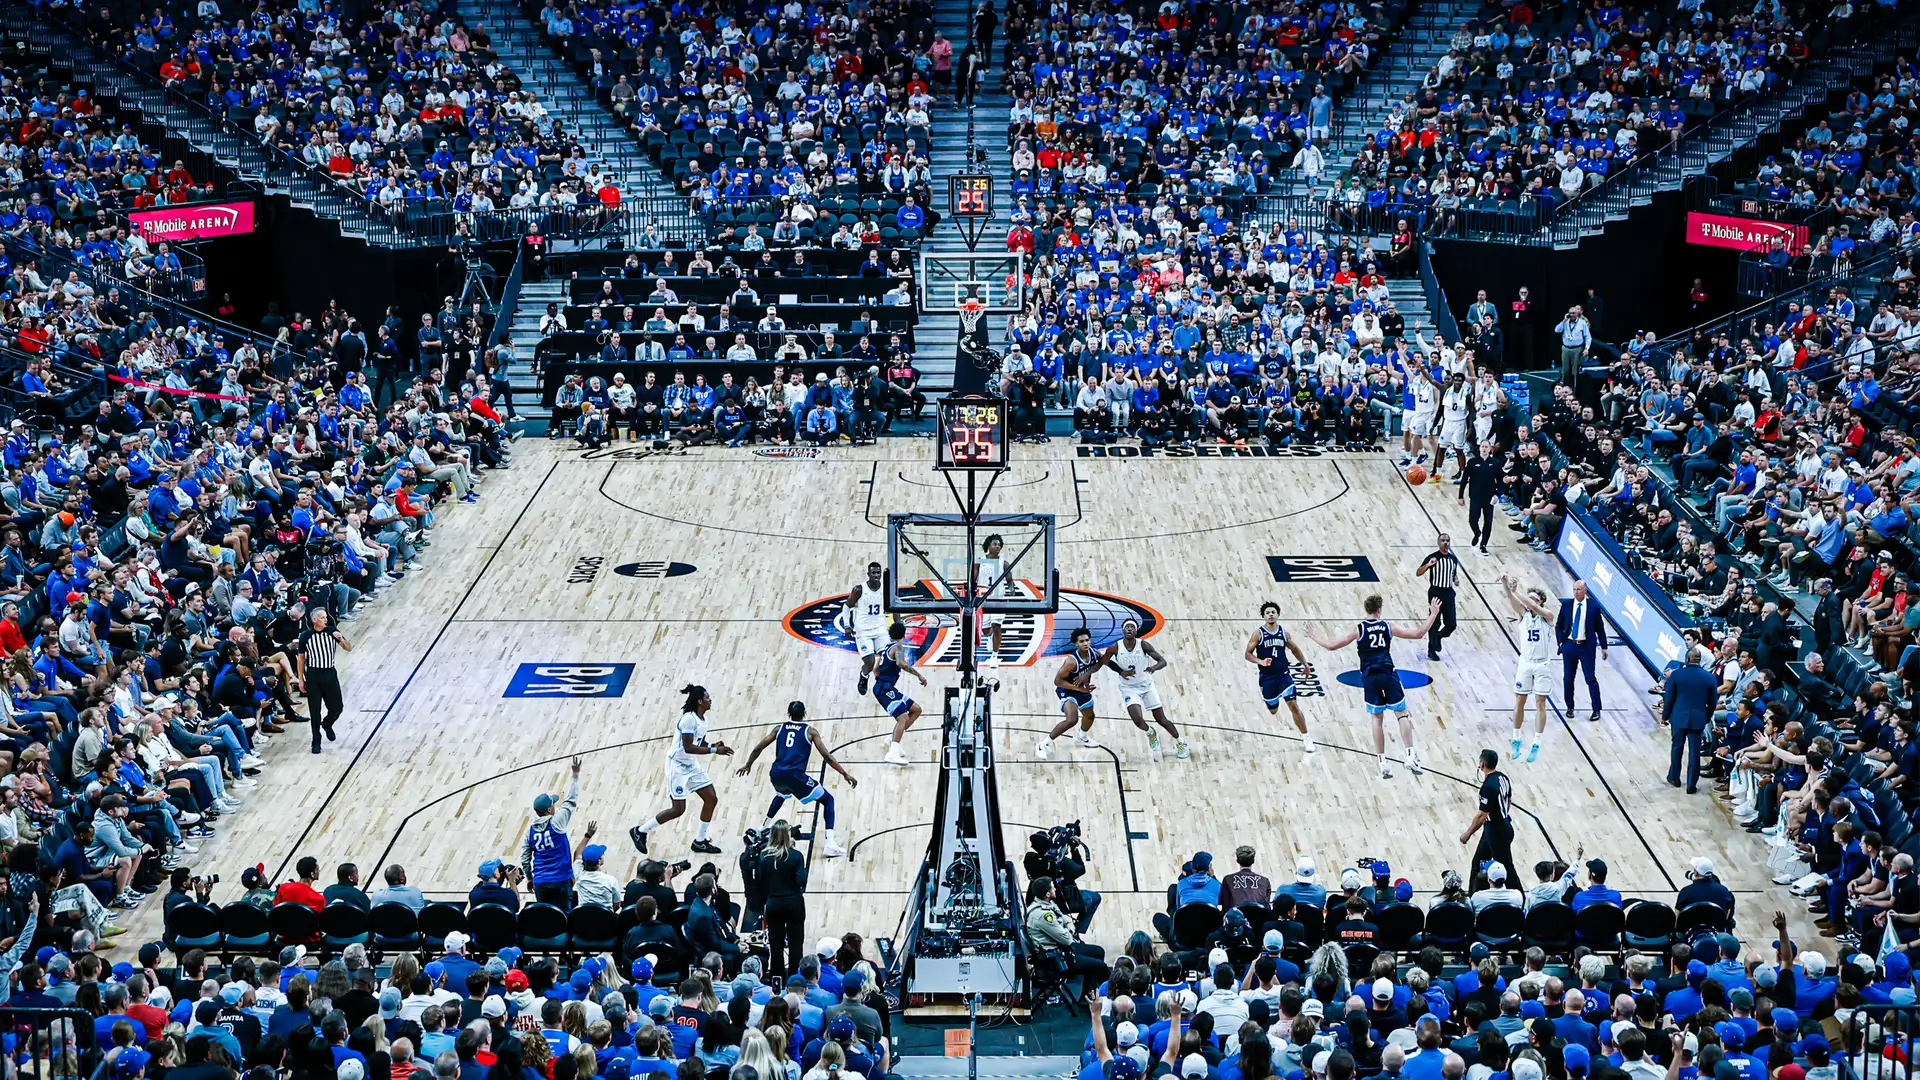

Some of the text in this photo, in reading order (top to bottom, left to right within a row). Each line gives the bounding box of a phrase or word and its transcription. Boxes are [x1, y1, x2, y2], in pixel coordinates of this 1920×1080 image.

[958, 191, 985, 212] 25
[1744, 201, 1756, 212] EXIT
[153, 217, 188, 233] Mobile
[190, 216, 229, 231] ARENA
[1711, 224, 1745, 240] Mobile
[1452, 402, 1459, 411] 0
[952, 427, 993, 460] 25
[567, 557, 604, 583] SPORTS
[868, 604, 881, 615] 13
[1369, 634, 1386, 648] 24
[1528, 630, 1540, 642] 15
[1272, 647, 1278, 658] 4
[1287, 662, 1326, 697] SPORTS
[786, 731, 796, 748] 6
[534, 830, 555, 851] 24
[1233, 875, 1261, 889] NY
